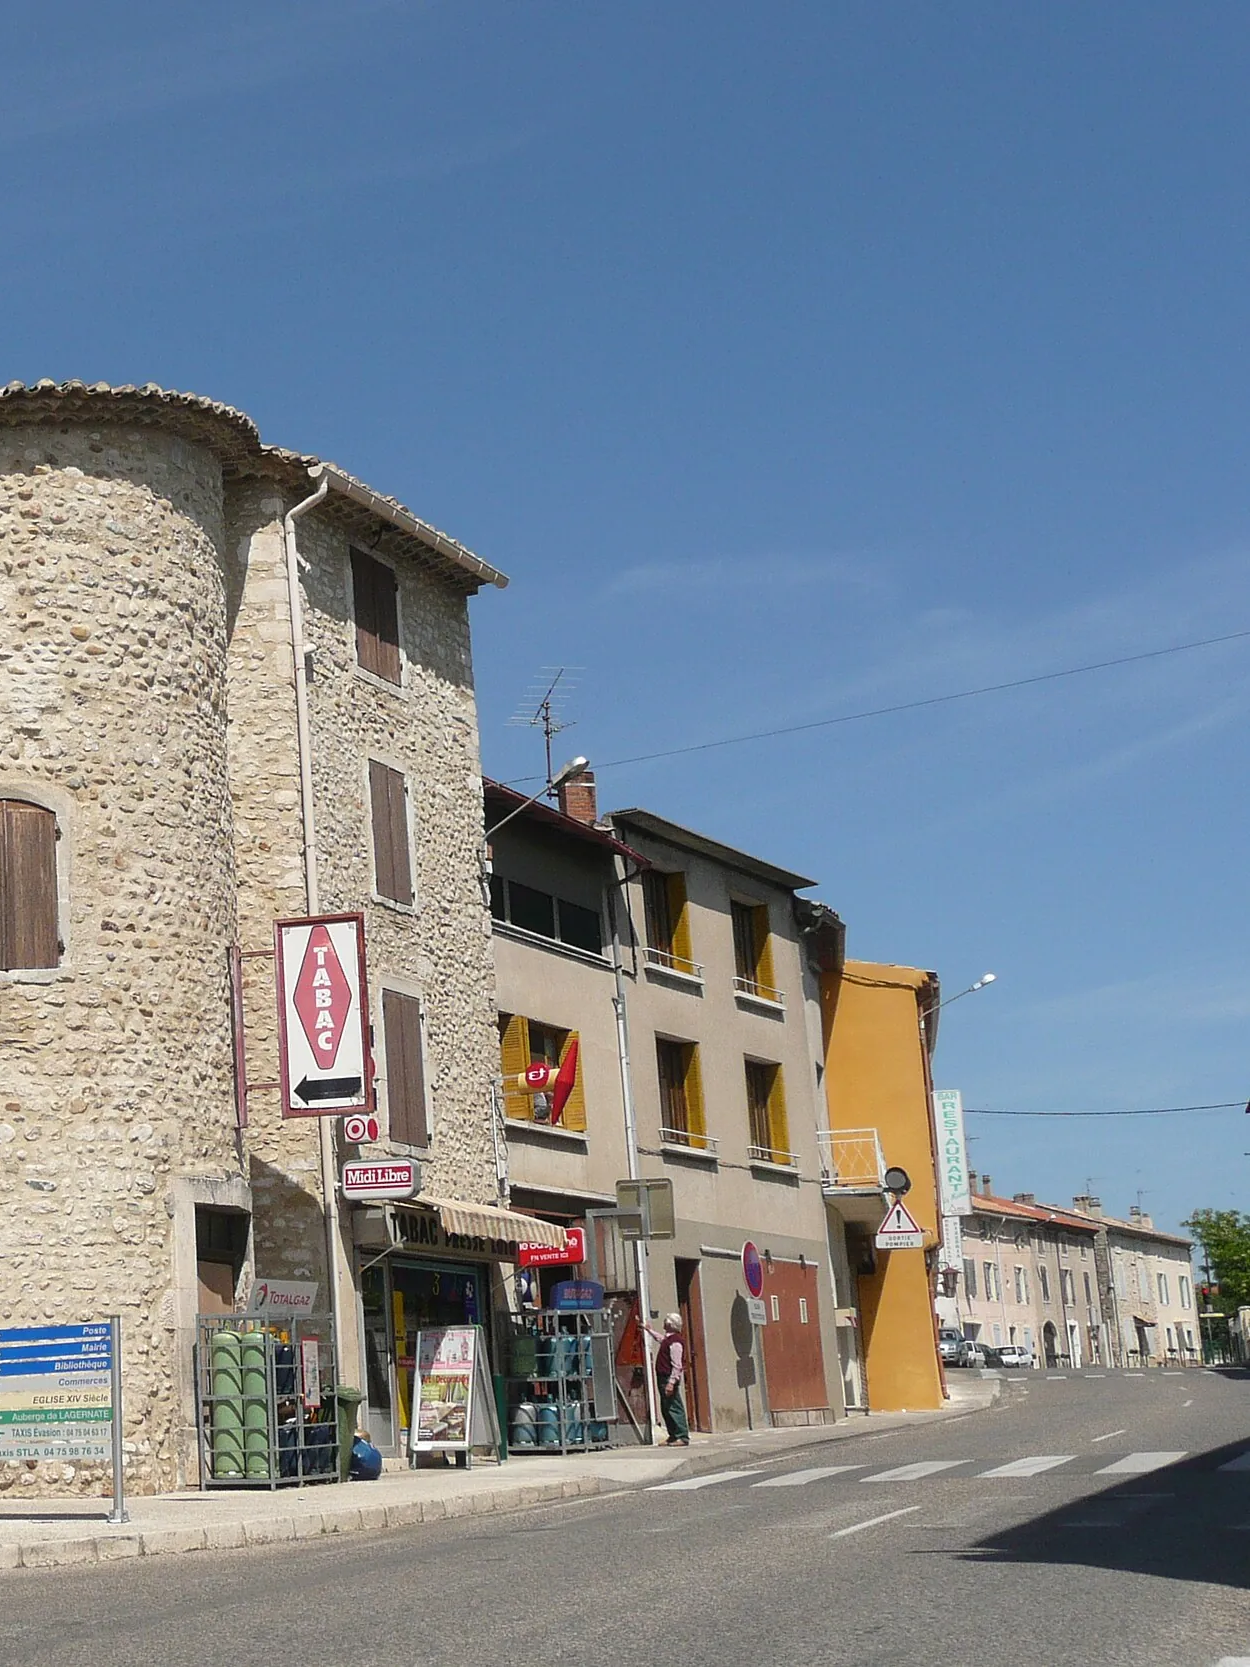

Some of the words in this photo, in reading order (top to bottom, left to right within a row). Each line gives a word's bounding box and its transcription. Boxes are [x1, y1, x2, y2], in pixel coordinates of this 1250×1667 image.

[312, 947, 334, 1050] TABAC
[937, 1092, 958, 1100] BAR
[941, 1102, 963, 1192] RESTAURANT
[347, 1169, 376, 1185] Midi
[377, 1169, 410, 1183] Libre
[390, 1212, 438, 1246] TABAC
[82, 1326, 107, 1336] Poste
[81, 1342, 107, 1352] Mairie
[54, 1360, 108, 1371] Bibliothèque
[58, 1376, 108, 1386] Commerces
[32, 1395, 64, 1404] EGLISE
[66, 1395, 81, 1403] XIV
[83, 1394, 109, 1402] Siècle
[11, 1412, 46, 1422] Auberge
[47, 1413, 58, 1421] de
[59, 1410, 110, 1420] LAGERNATE
[11, 1428, 32, 1438] TAXIS
[33, 1426, 61, 1437] Évasion
[66, 1429, 74, 1437] 04
[16, 1448, 40, 1457] STLA
[44, 1448, 54, 1456] 04
[57, 1448, 67, 1456] 75
[69, 1448, 80, 1456] 98
[81, 1447, 92, 1455] 76
[94, 1446, 104, 1455] 34
